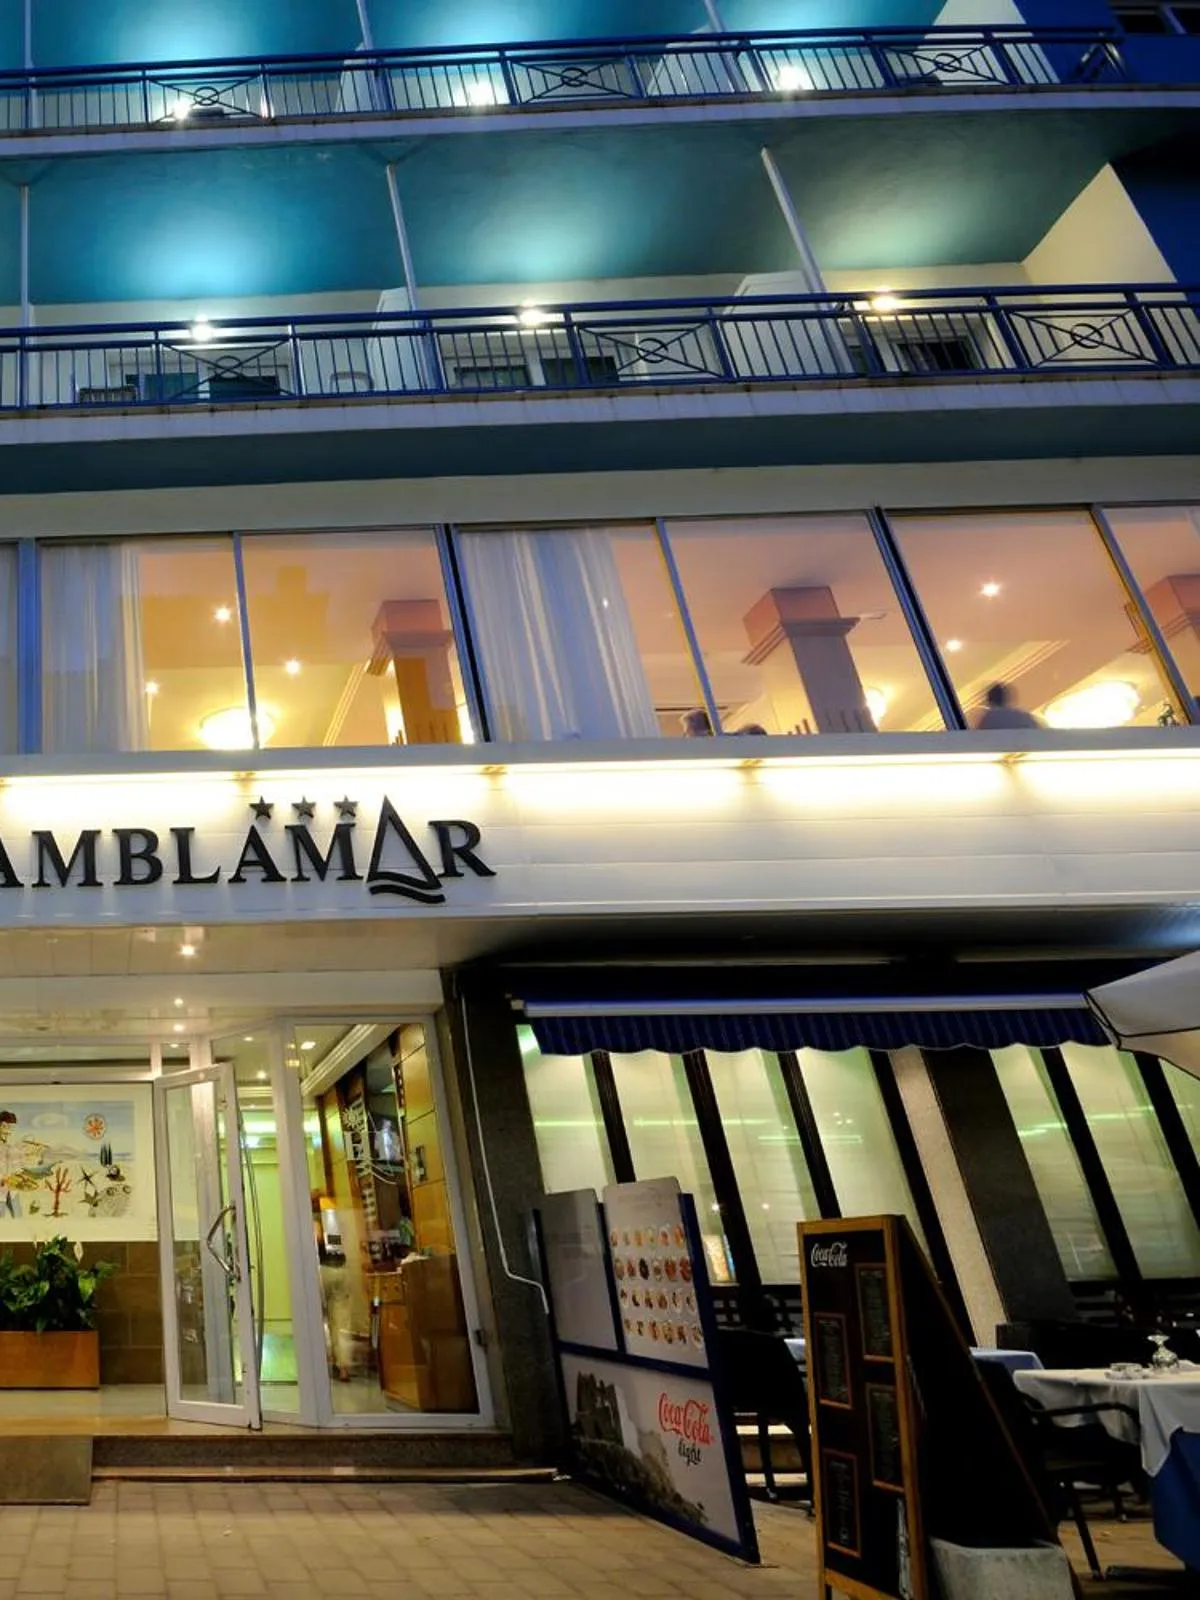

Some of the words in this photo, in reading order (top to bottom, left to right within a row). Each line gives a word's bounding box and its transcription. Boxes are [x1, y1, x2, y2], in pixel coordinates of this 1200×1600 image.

[810, 1241, 848, 1268] Coca-Cola
[658, 1392, 712, 1446] Coca-Cola
[678, 1438, 702, 1468] light
